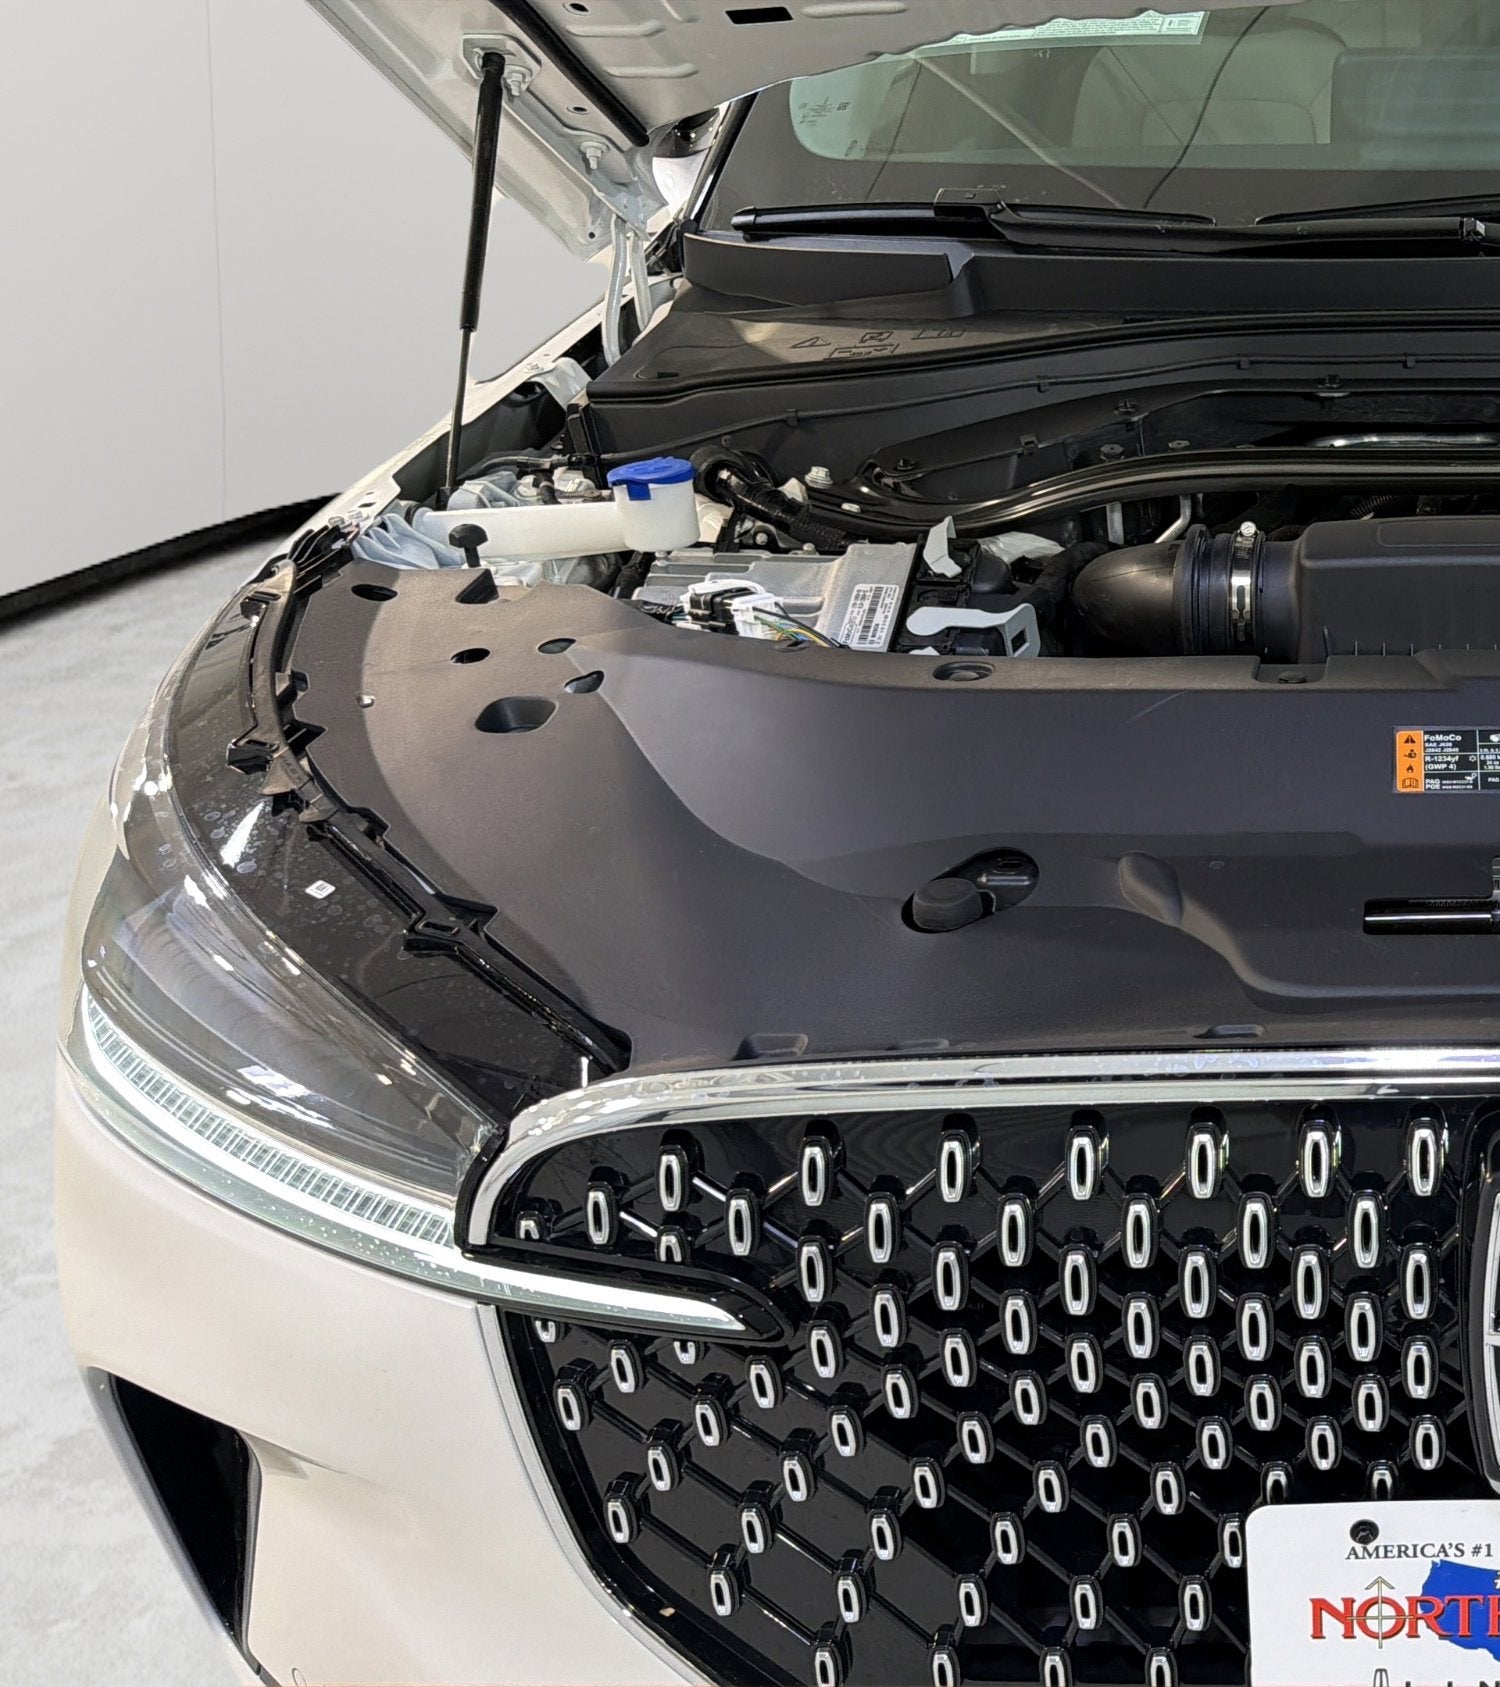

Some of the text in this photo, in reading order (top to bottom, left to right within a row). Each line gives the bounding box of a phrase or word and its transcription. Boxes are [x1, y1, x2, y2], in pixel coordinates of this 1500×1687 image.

[1425, 755, 1459, 763] R-1234yf
[1345, 1542, 1465, 1560] AMERICA'S
[1471, 1543, 1493, 1557] #1
